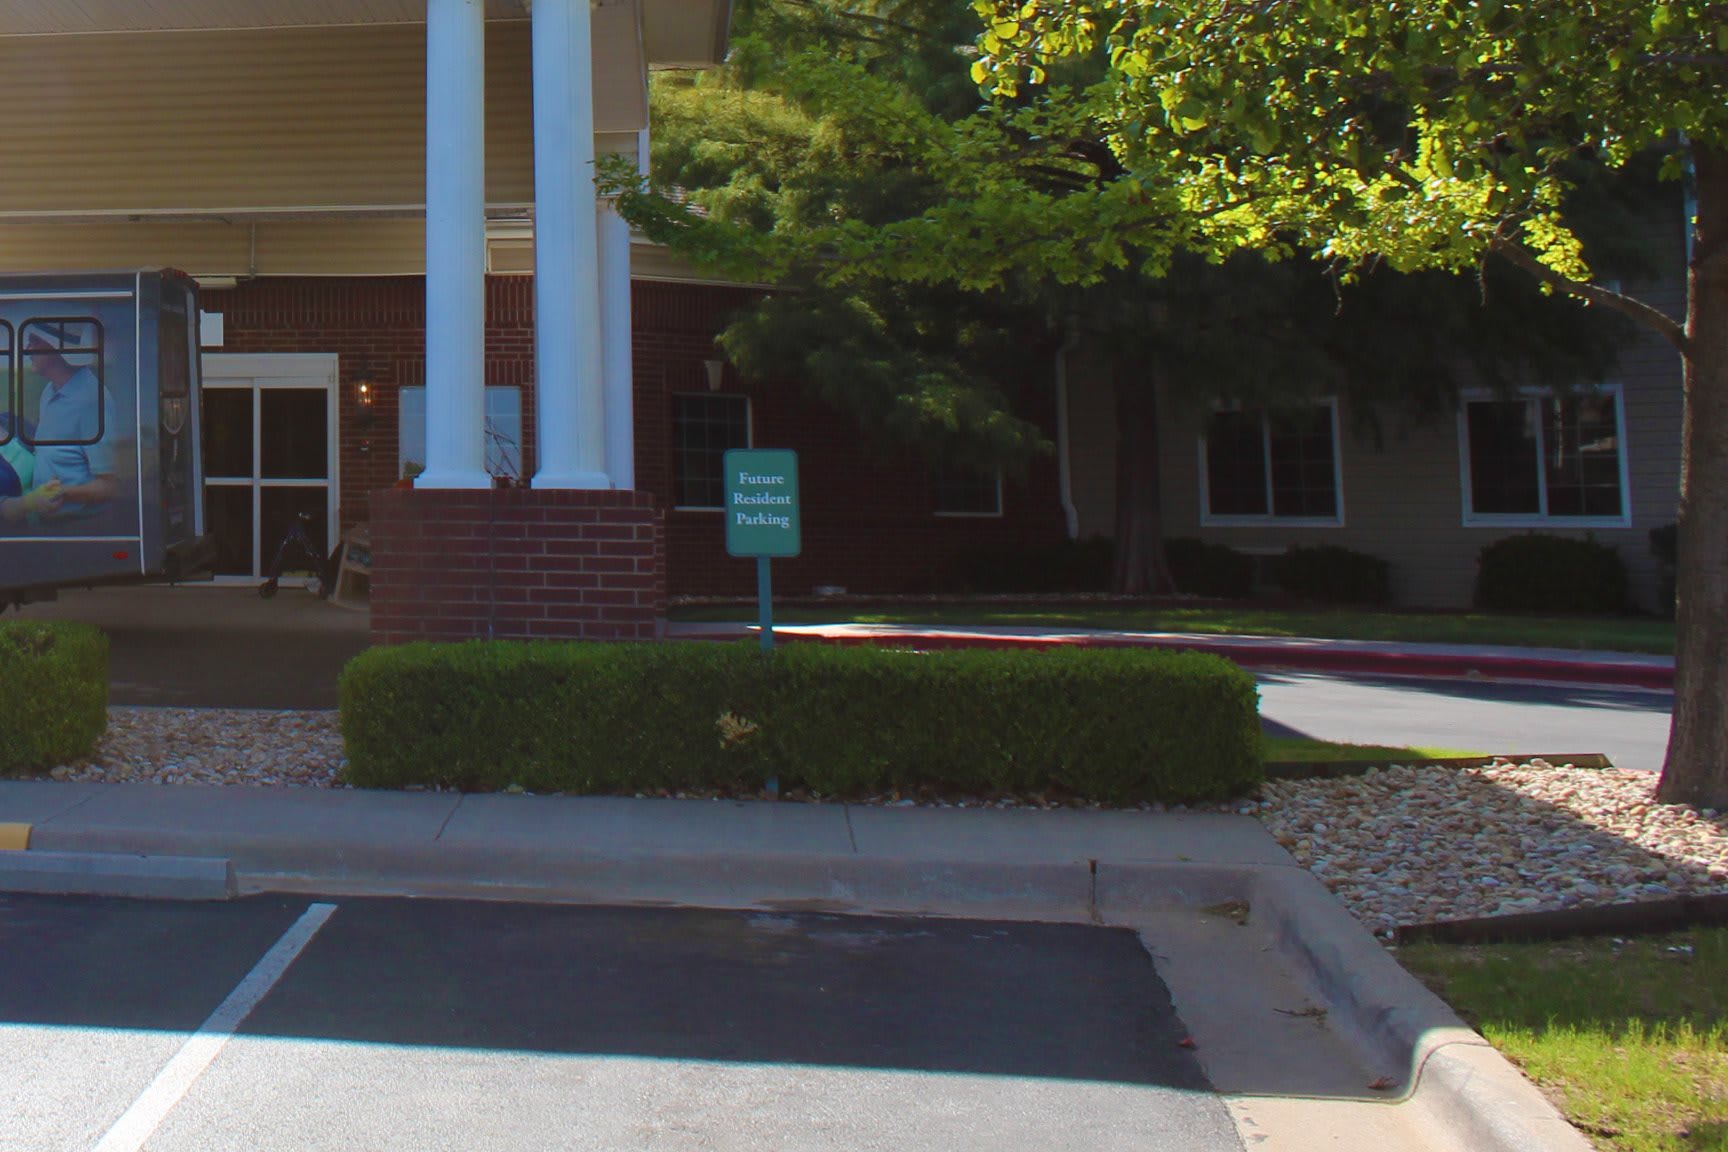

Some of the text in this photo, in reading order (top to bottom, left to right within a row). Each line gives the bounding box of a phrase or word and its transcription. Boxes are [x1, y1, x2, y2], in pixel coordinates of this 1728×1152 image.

[739, 472, 785, 484] Future
[733, 492, 792, 505] Resident
[736, 512, 790, 529] Parking
